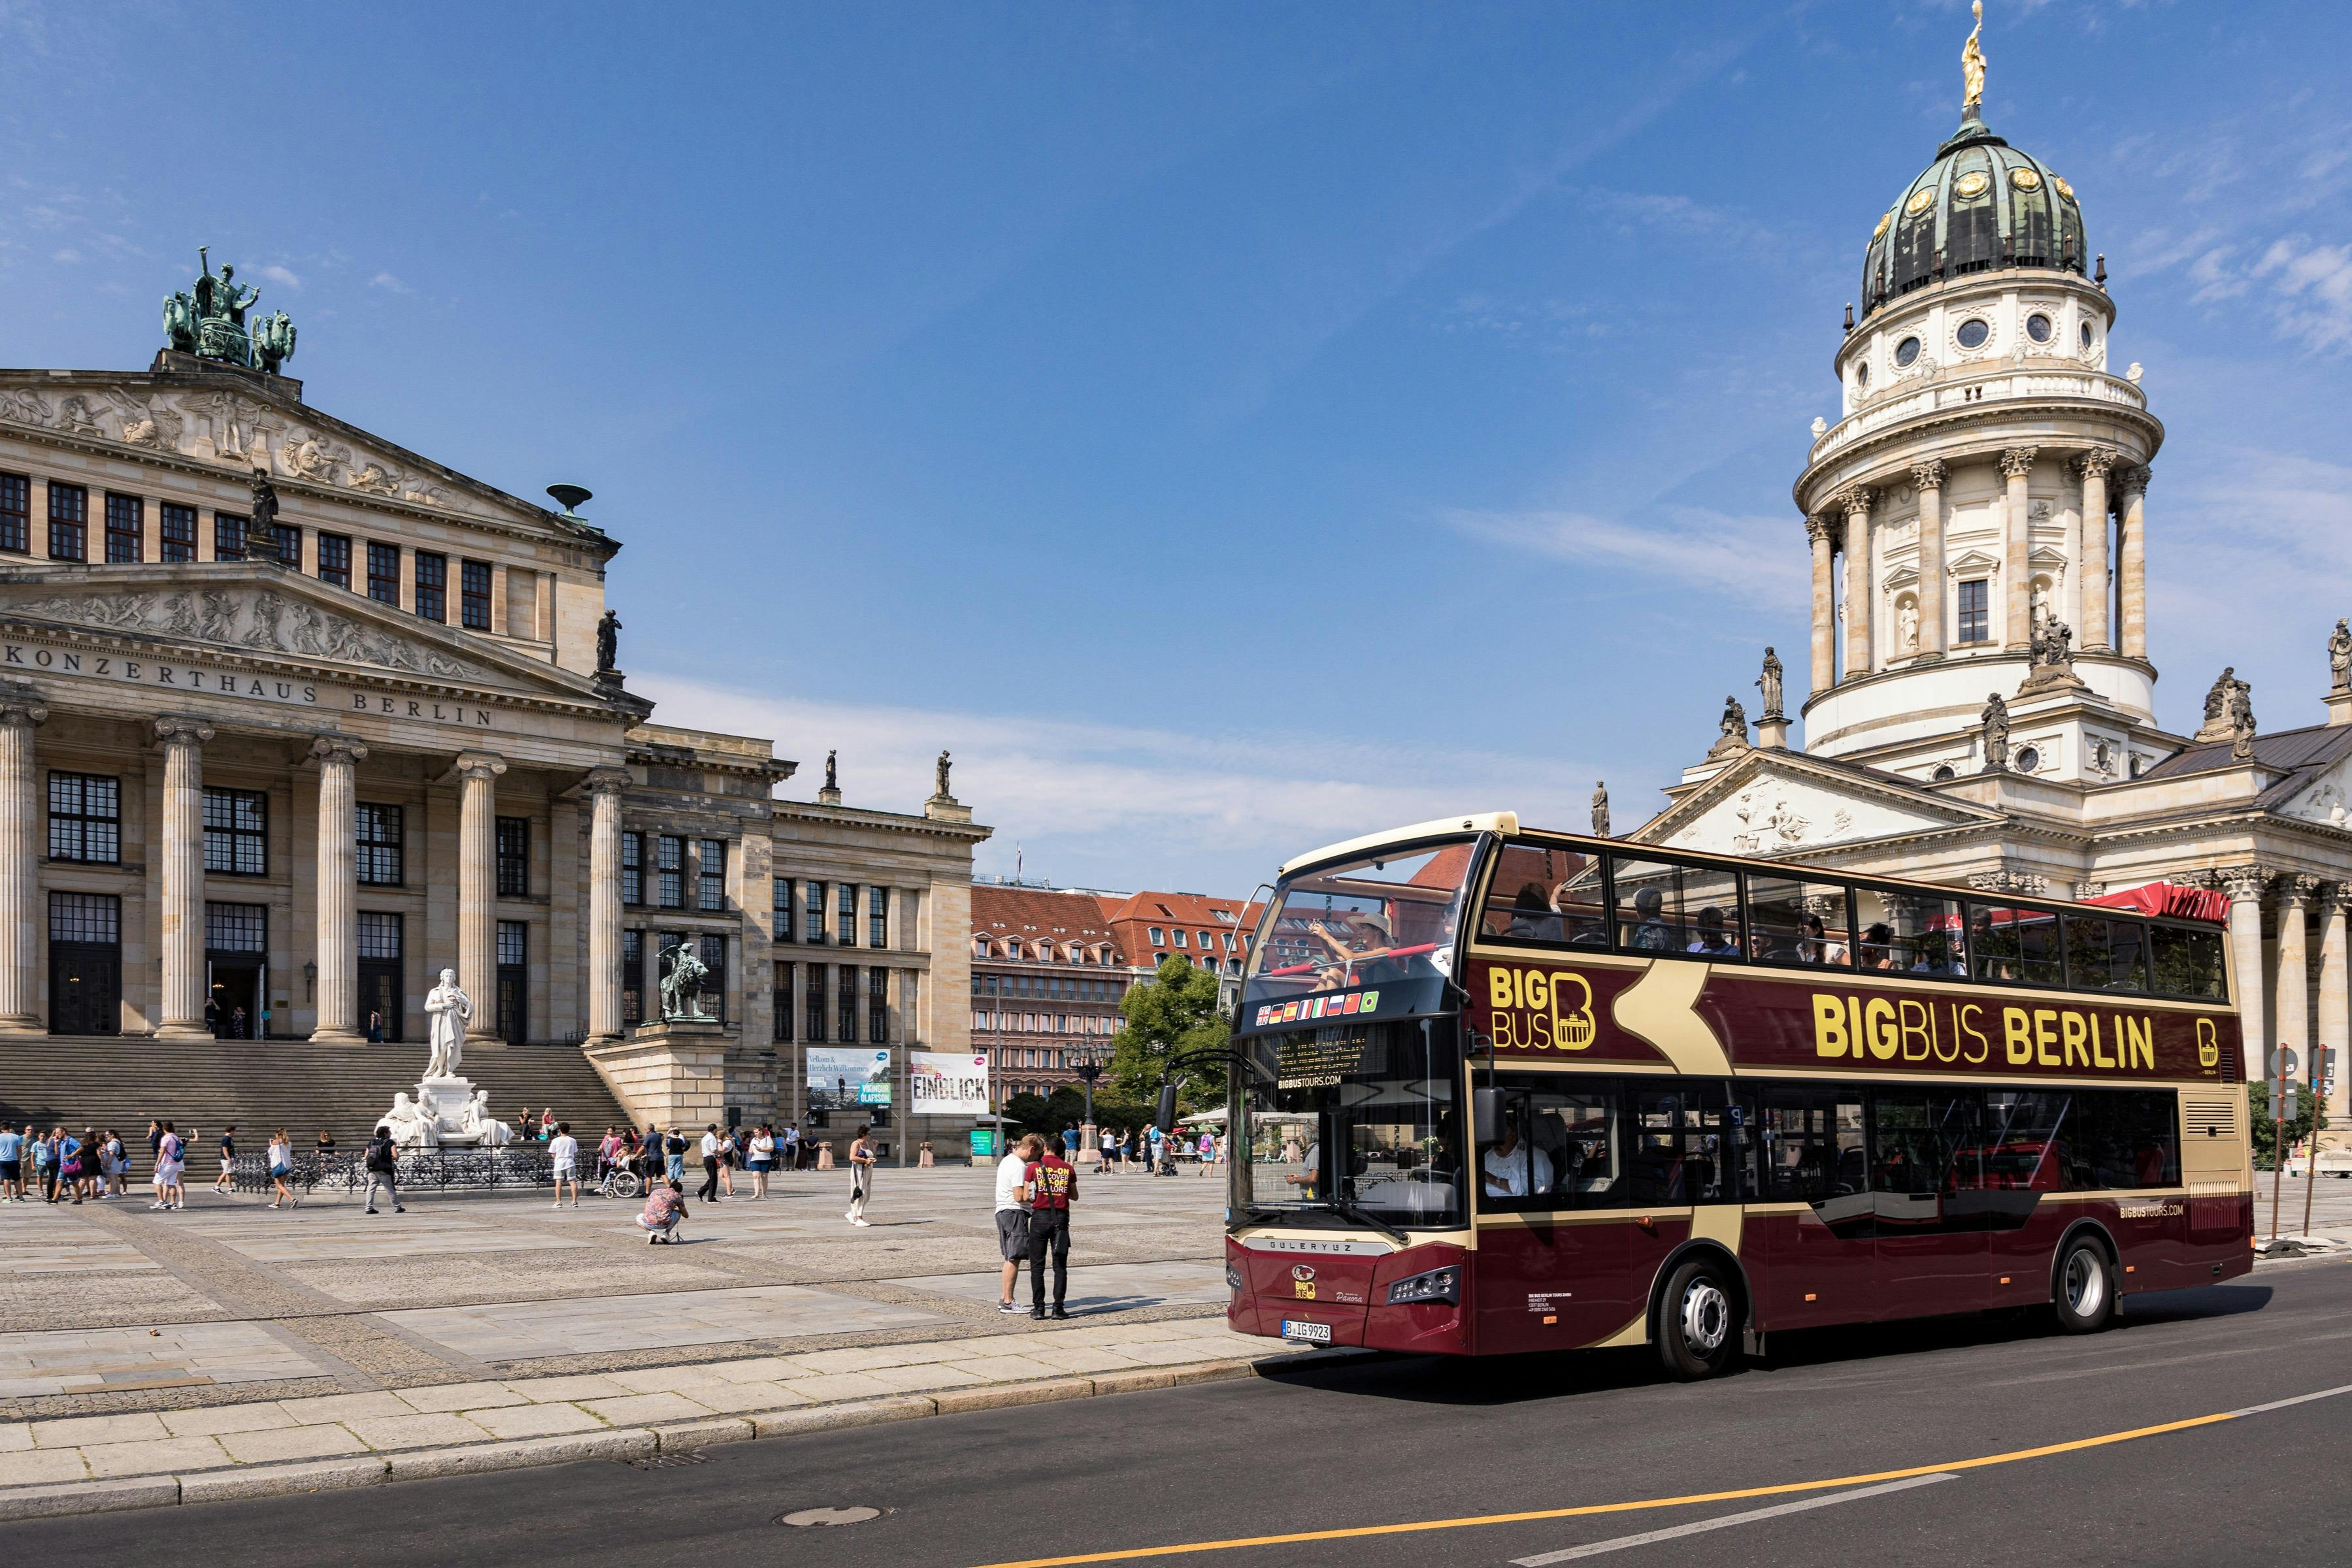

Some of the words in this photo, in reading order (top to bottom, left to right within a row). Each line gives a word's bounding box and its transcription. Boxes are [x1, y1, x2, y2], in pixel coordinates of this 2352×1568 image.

[5, 645, 316, 703] KONZERTHAUS
[353, 693, 491, 726] BERLIN
[1489, 967, 1548, 1010] BIG
[1491, 1011, 1551, 1049] BUS
[2003, 1007, 2155, 1070] BERLIN
[914, 1076, 986, 1100] EINBLICK
[1278, 1075, 1341, 1090] BIGBUSTOURS.COM
[2120, 1205, 2183, 1218] BIGBUSTOURS.COM
[1295, 1281, 1306, 1290] BIG
[1296, 1290, 1307, 1299] BUS
[1336, 1292, 1363, 1303] Panora
[1287, 1322, 1292, 1333] B
[1297, 1324, 1307, 1335] IG
[1309, 1325, 1329, 1339] 9923
